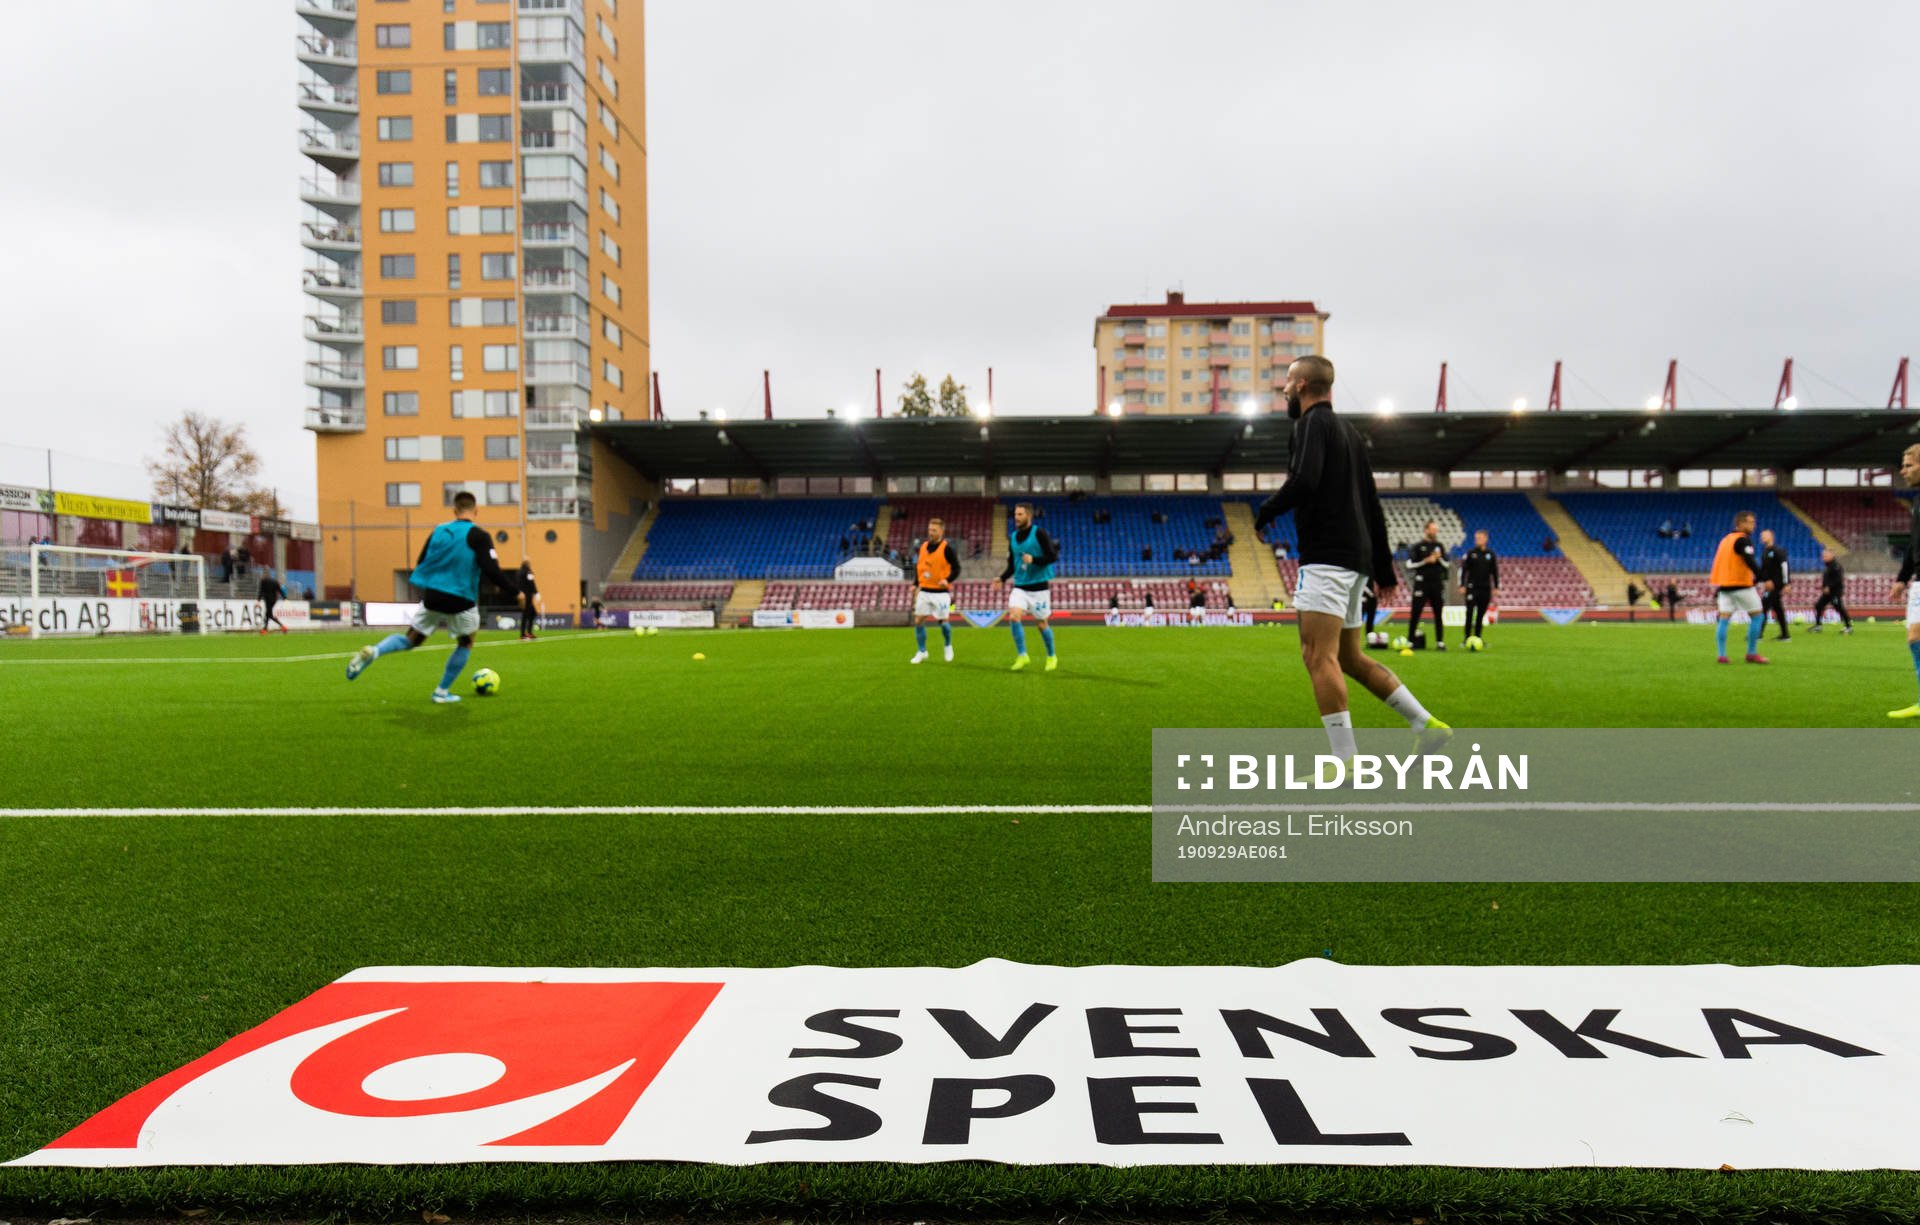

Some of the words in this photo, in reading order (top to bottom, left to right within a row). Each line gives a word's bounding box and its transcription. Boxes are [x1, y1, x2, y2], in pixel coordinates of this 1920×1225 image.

[77, 601, 111, 630] AB
[241, 603, 264, 628] AB
[788, 1003, 1884, 1060] SVENSKA
[744, 1073, 1413, 1146] SPEL
